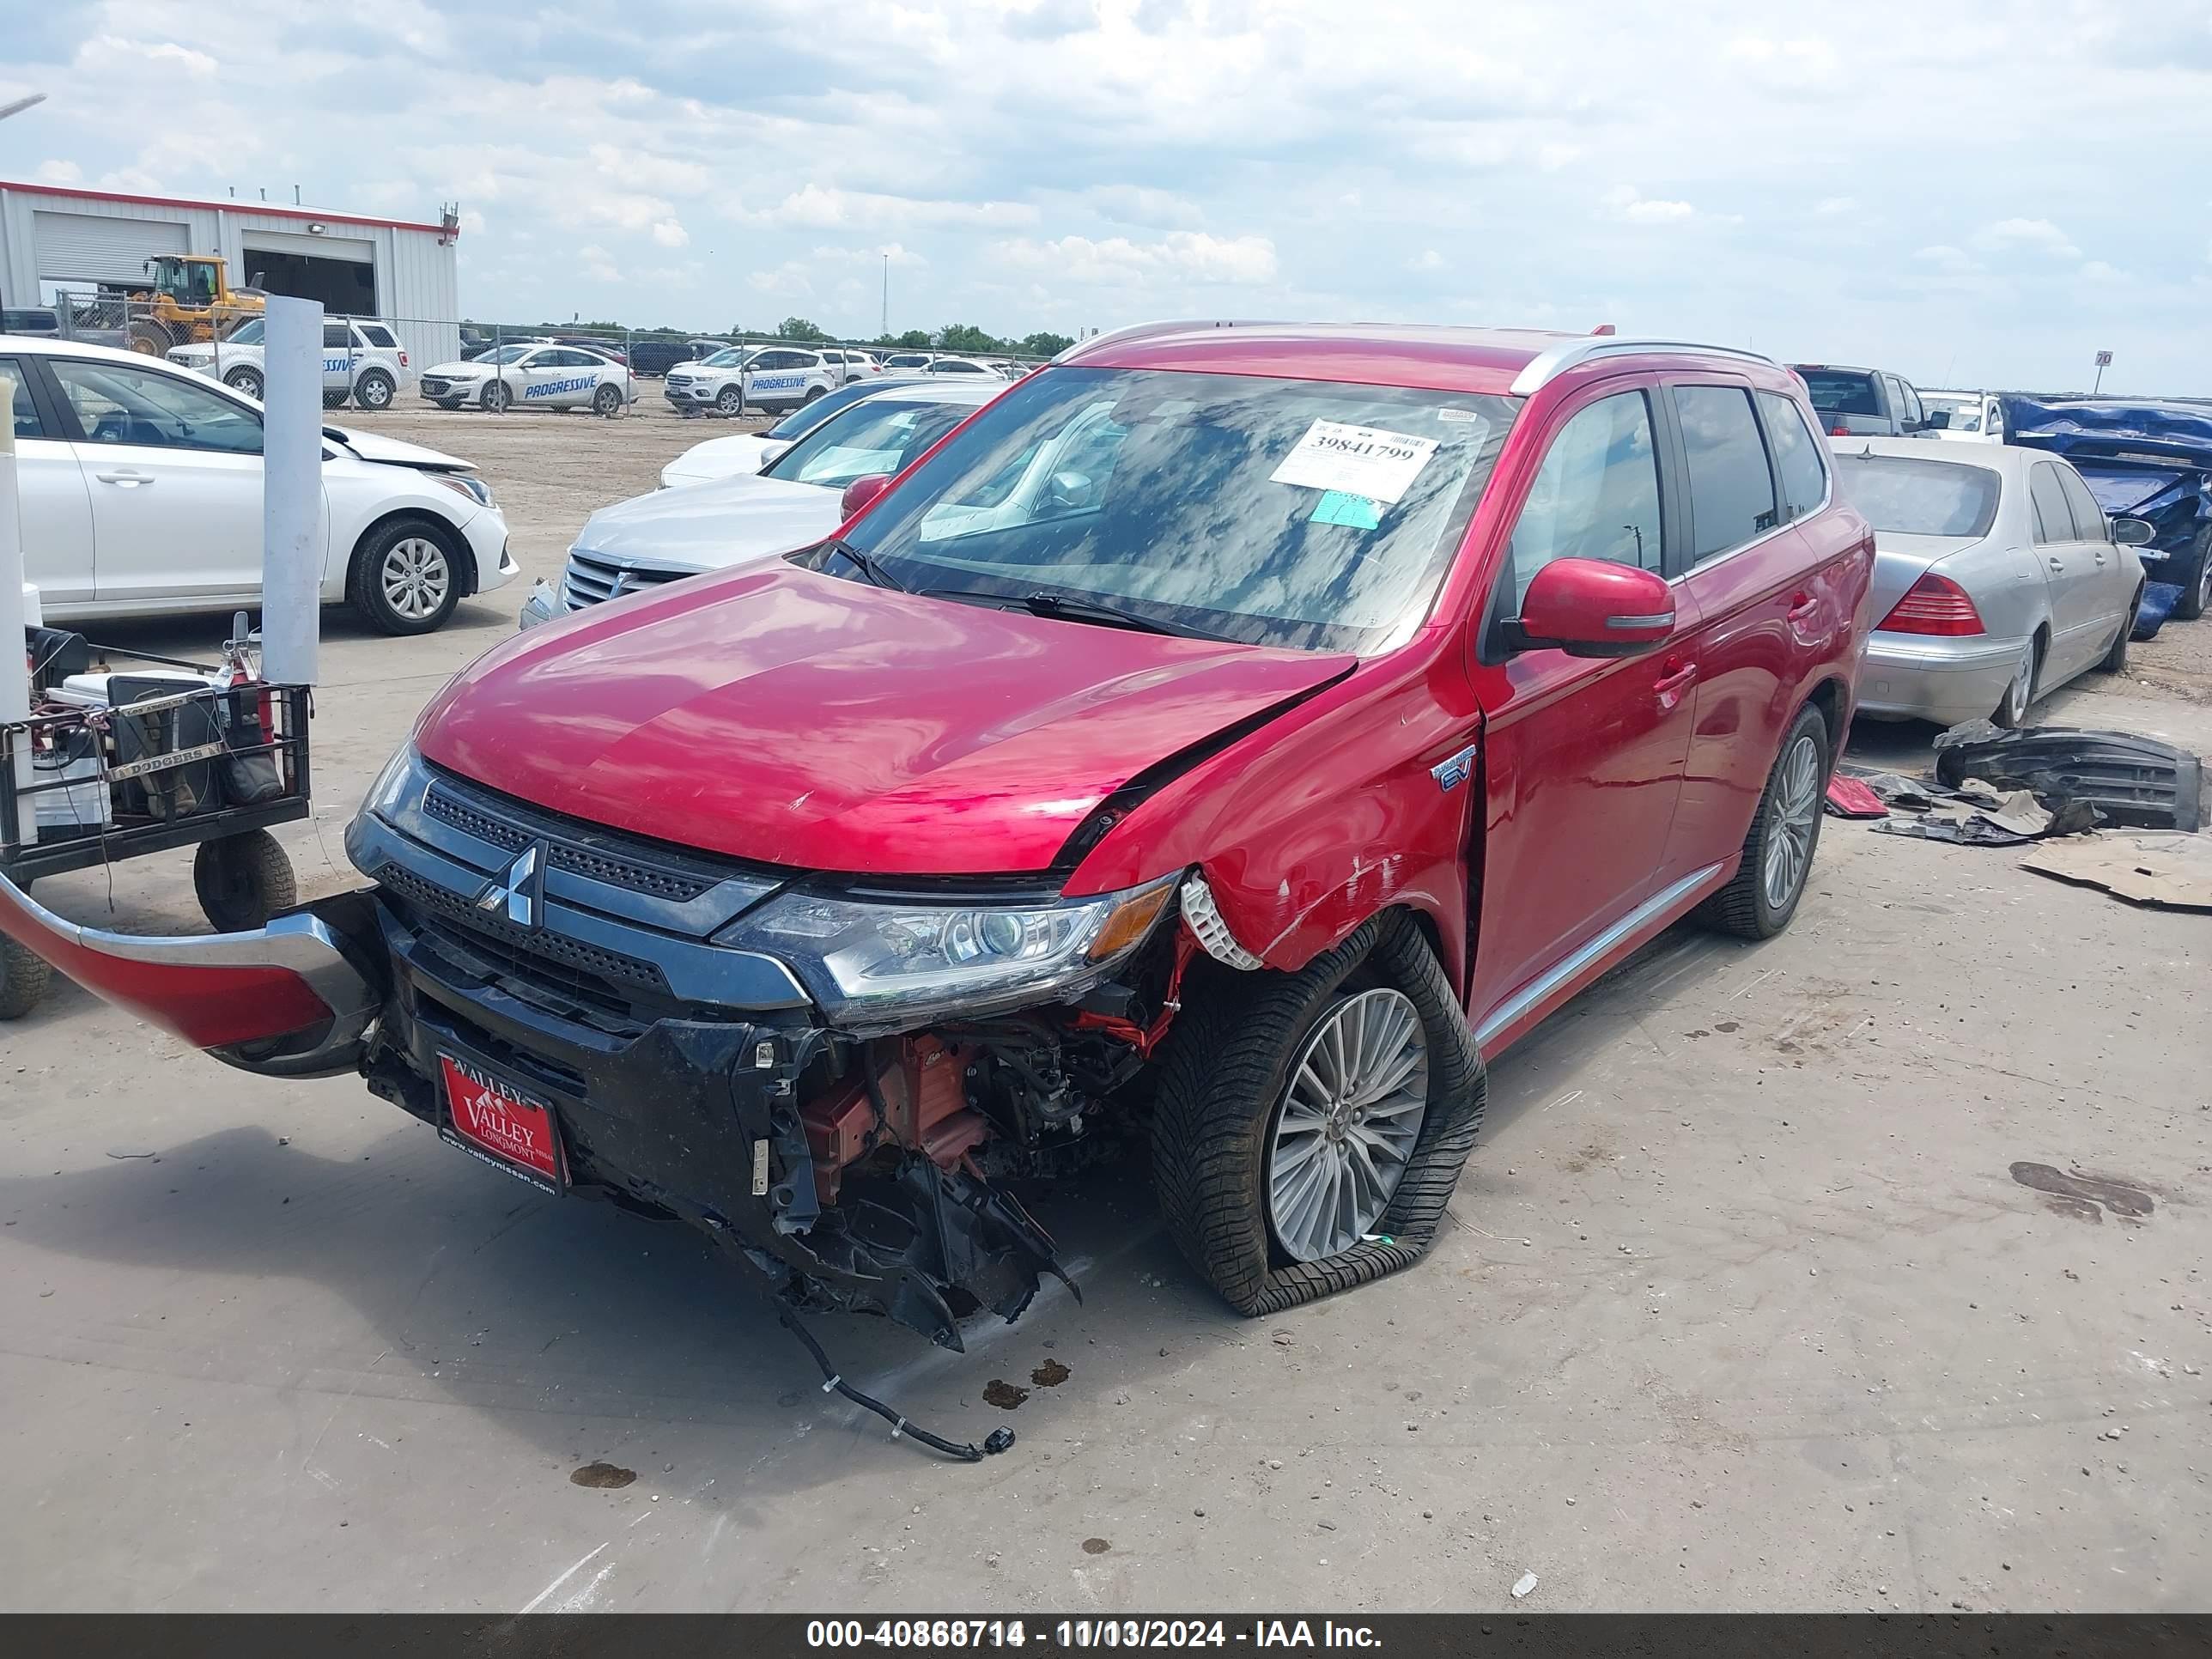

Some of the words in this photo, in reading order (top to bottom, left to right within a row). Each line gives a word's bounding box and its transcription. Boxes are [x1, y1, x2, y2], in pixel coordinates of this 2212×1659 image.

[2097, 353, 2111, 363] 70
[525, 374, 598, 398] PROGRESSIVE
[751, 377, 806, 390] PROGRESSIVE
[1311, 436, 1414, 461] 39841799
[132, 750, 203, 773] DODGERS
[457, 1060, 522, 1106] VALLEY
[464, 1096, 534, 1148] VALLEY
[481, 1127, 535, 1161] LONGMONT
[442, 1134, 556, 1195] www.valleynissan.com
